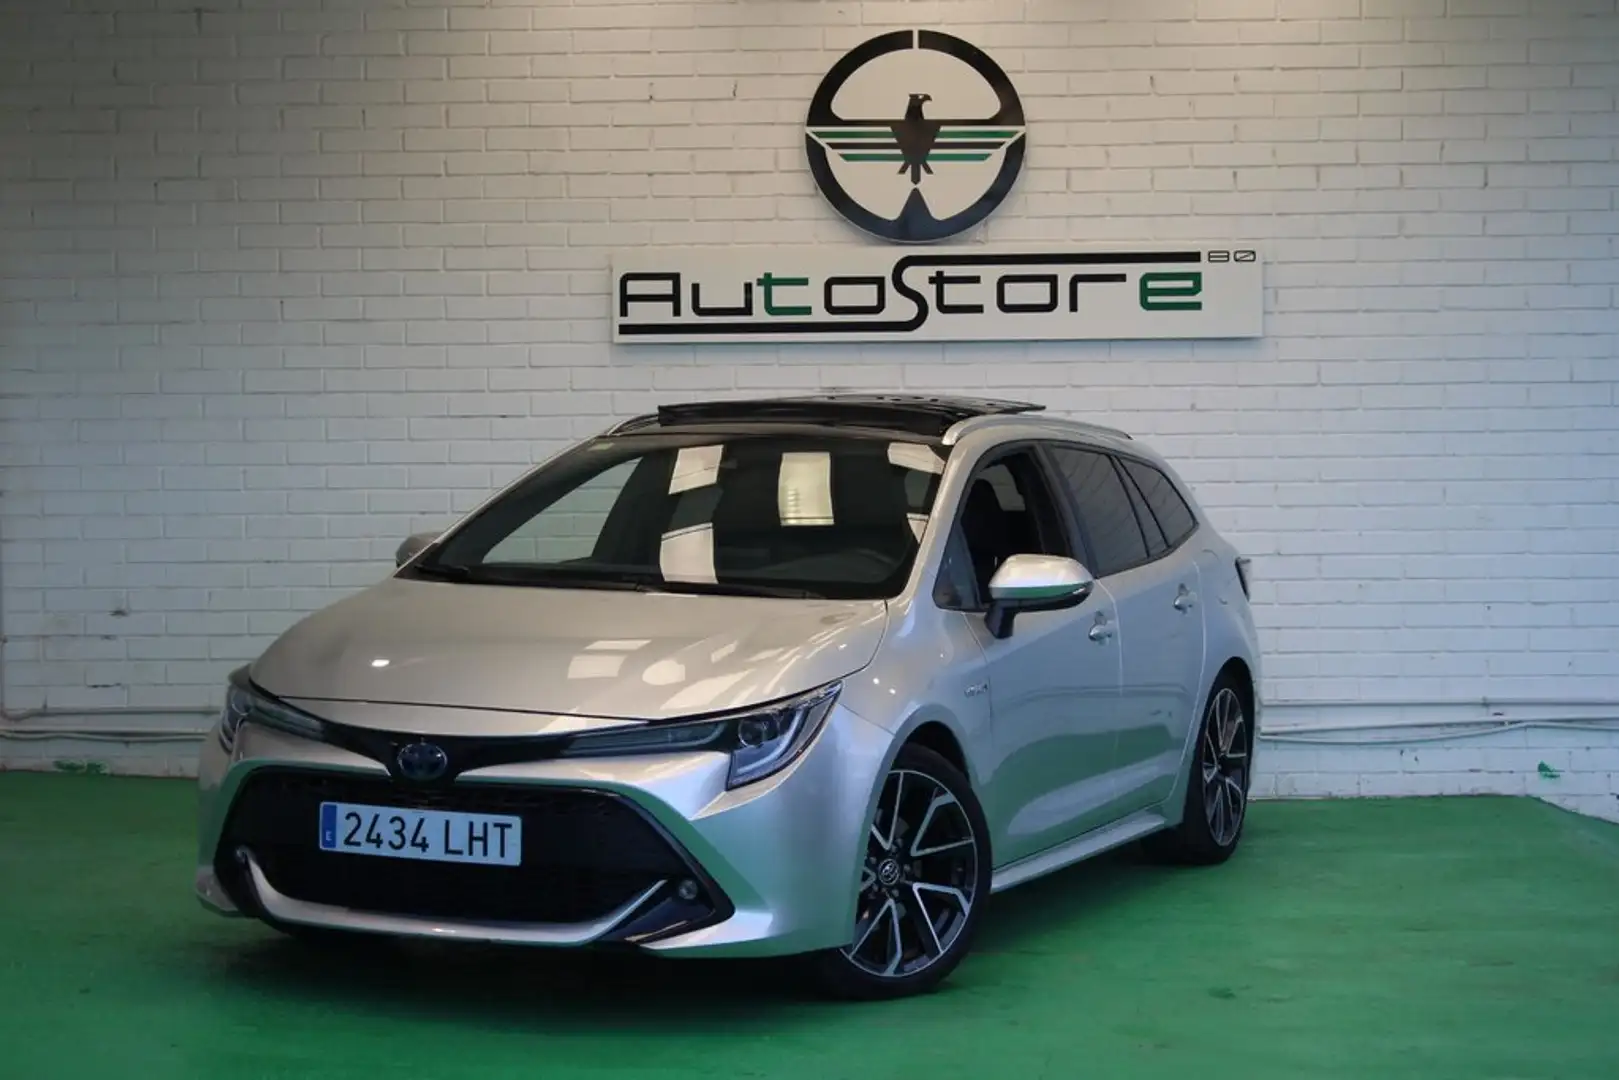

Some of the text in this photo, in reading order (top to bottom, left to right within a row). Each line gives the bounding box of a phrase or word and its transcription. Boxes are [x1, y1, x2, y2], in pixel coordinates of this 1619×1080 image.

[618, 251, 1202, 335] AutoStore
[343, 811, 513, 858] 2434 LHT
